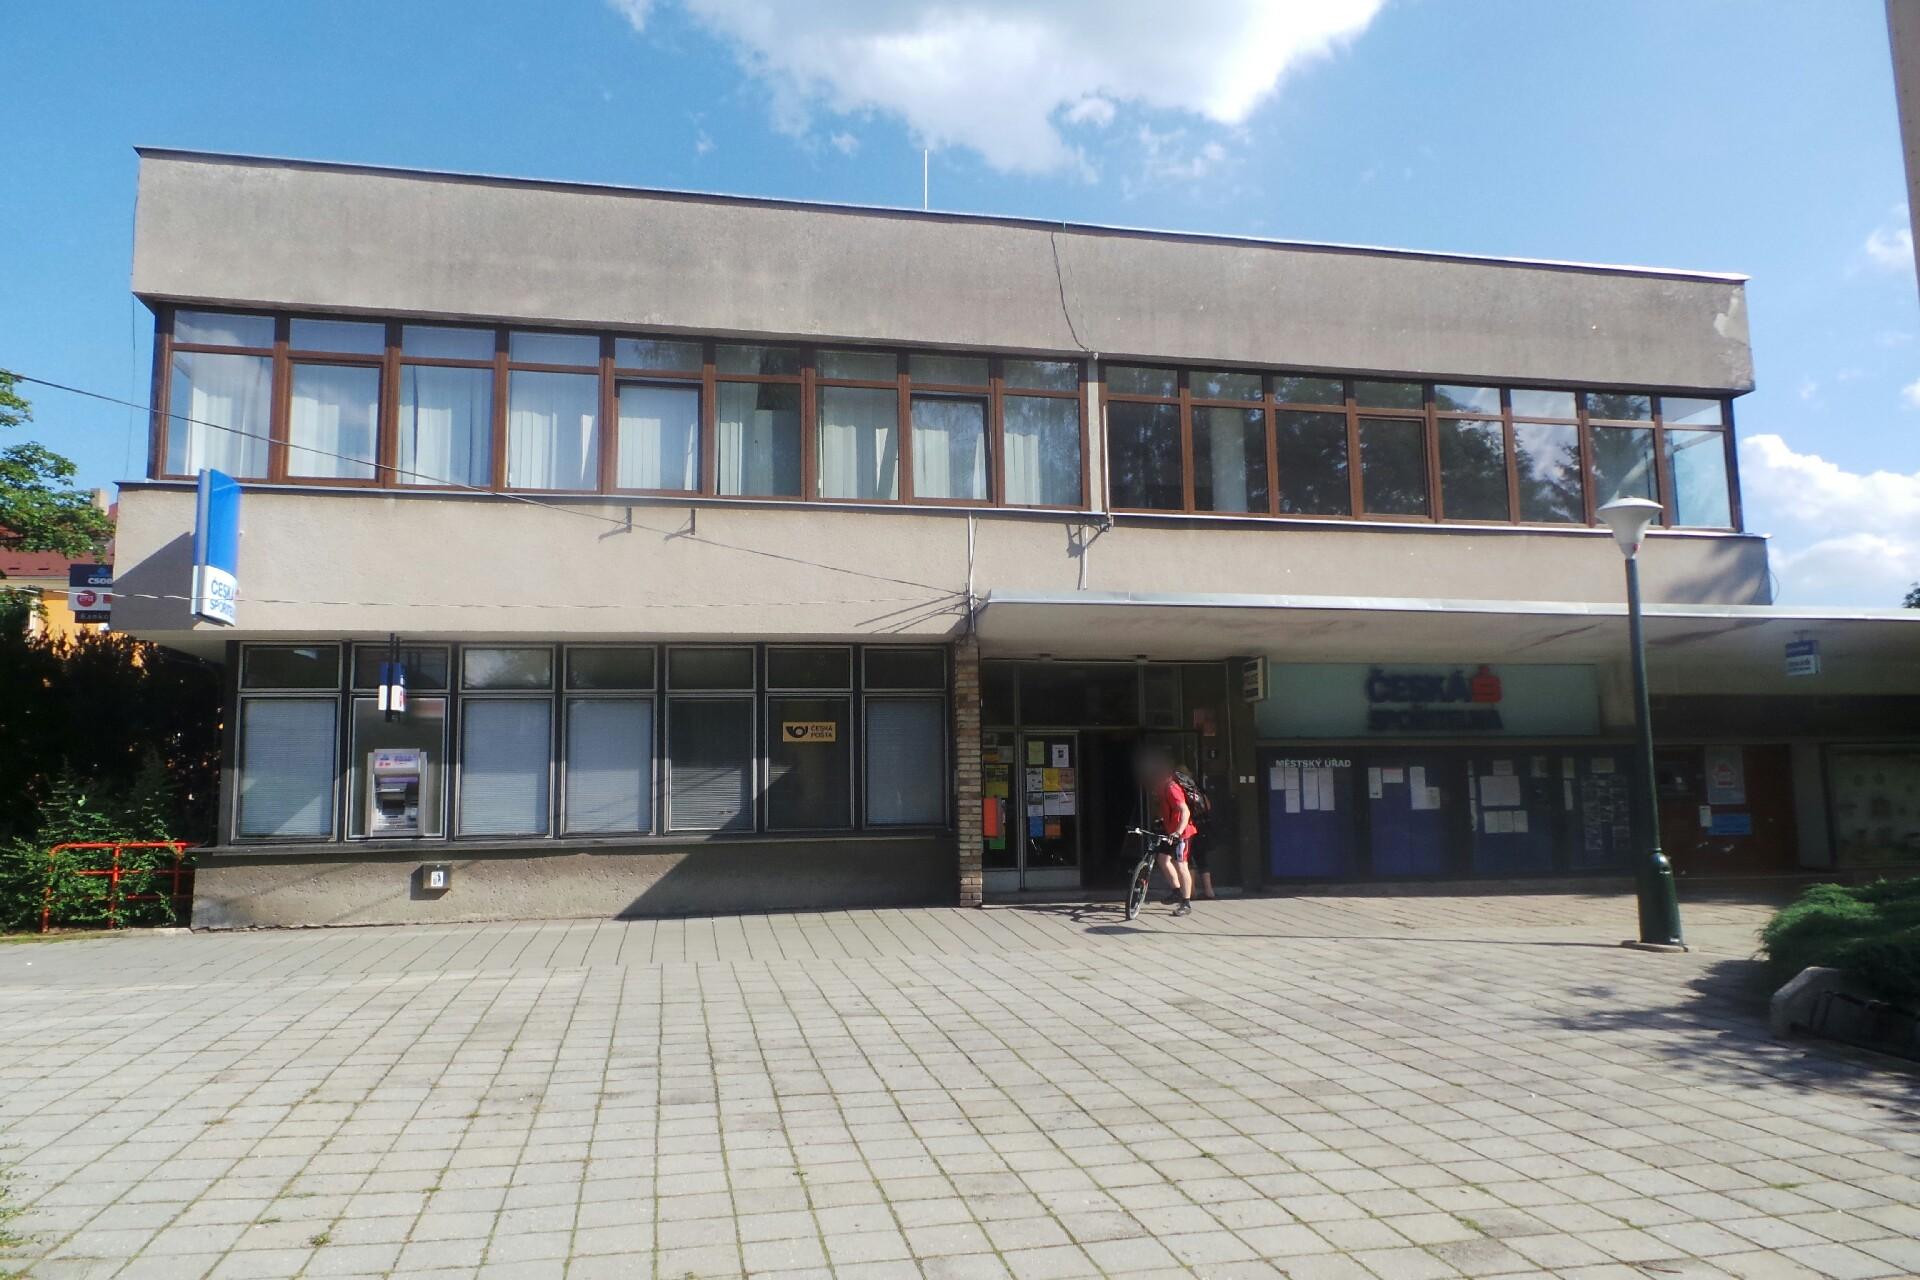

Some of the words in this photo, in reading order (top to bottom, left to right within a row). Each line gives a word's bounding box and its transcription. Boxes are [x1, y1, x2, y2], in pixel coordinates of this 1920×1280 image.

[1366, 668, 1472, 703] ČESKÁ
[1275, 758, 1322, 768] MĚSTSKÝ
[1324, 757, 1352, 768] ÚŘAD
